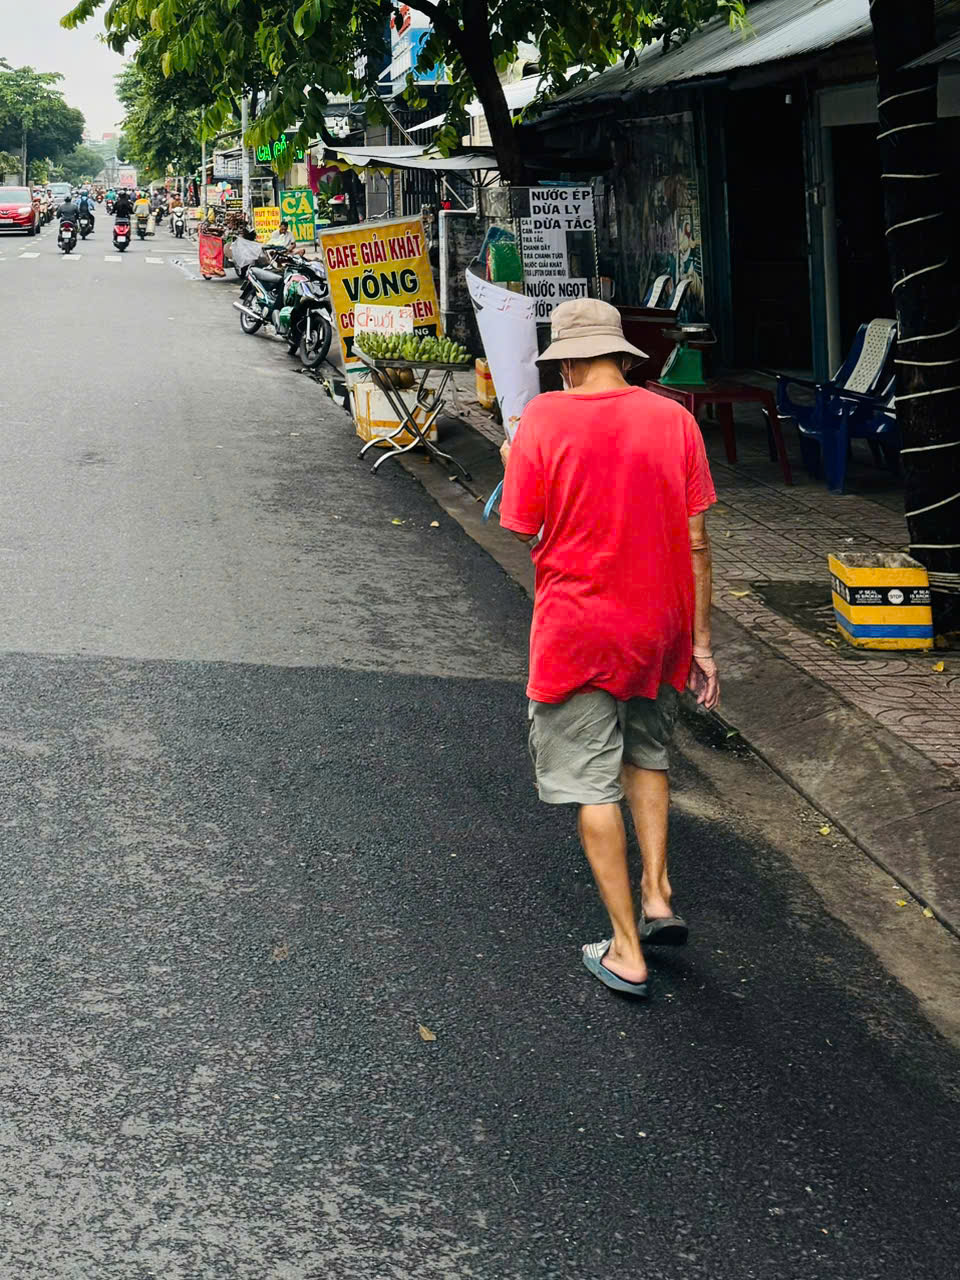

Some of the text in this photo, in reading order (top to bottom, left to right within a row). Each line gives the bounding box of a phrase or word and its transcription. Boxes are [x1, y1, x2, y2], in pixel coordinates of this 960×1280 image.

[531, 188, 591, 200] NƯỚC ÉP
[533, 202, 581, 215] DỪA LY
[534, 216, 562, 230] DỪA
[565, 216, 593, 229] TẮC
[327, 230, 422, 270] CAFE GIẢI KHÁT
[342, 268, 419, 302] VÕNG
[526, 280, 556, 298] NƯỚC
[404, 299, 434, 321] IỆN
[414, 327, 429, 337] NG
